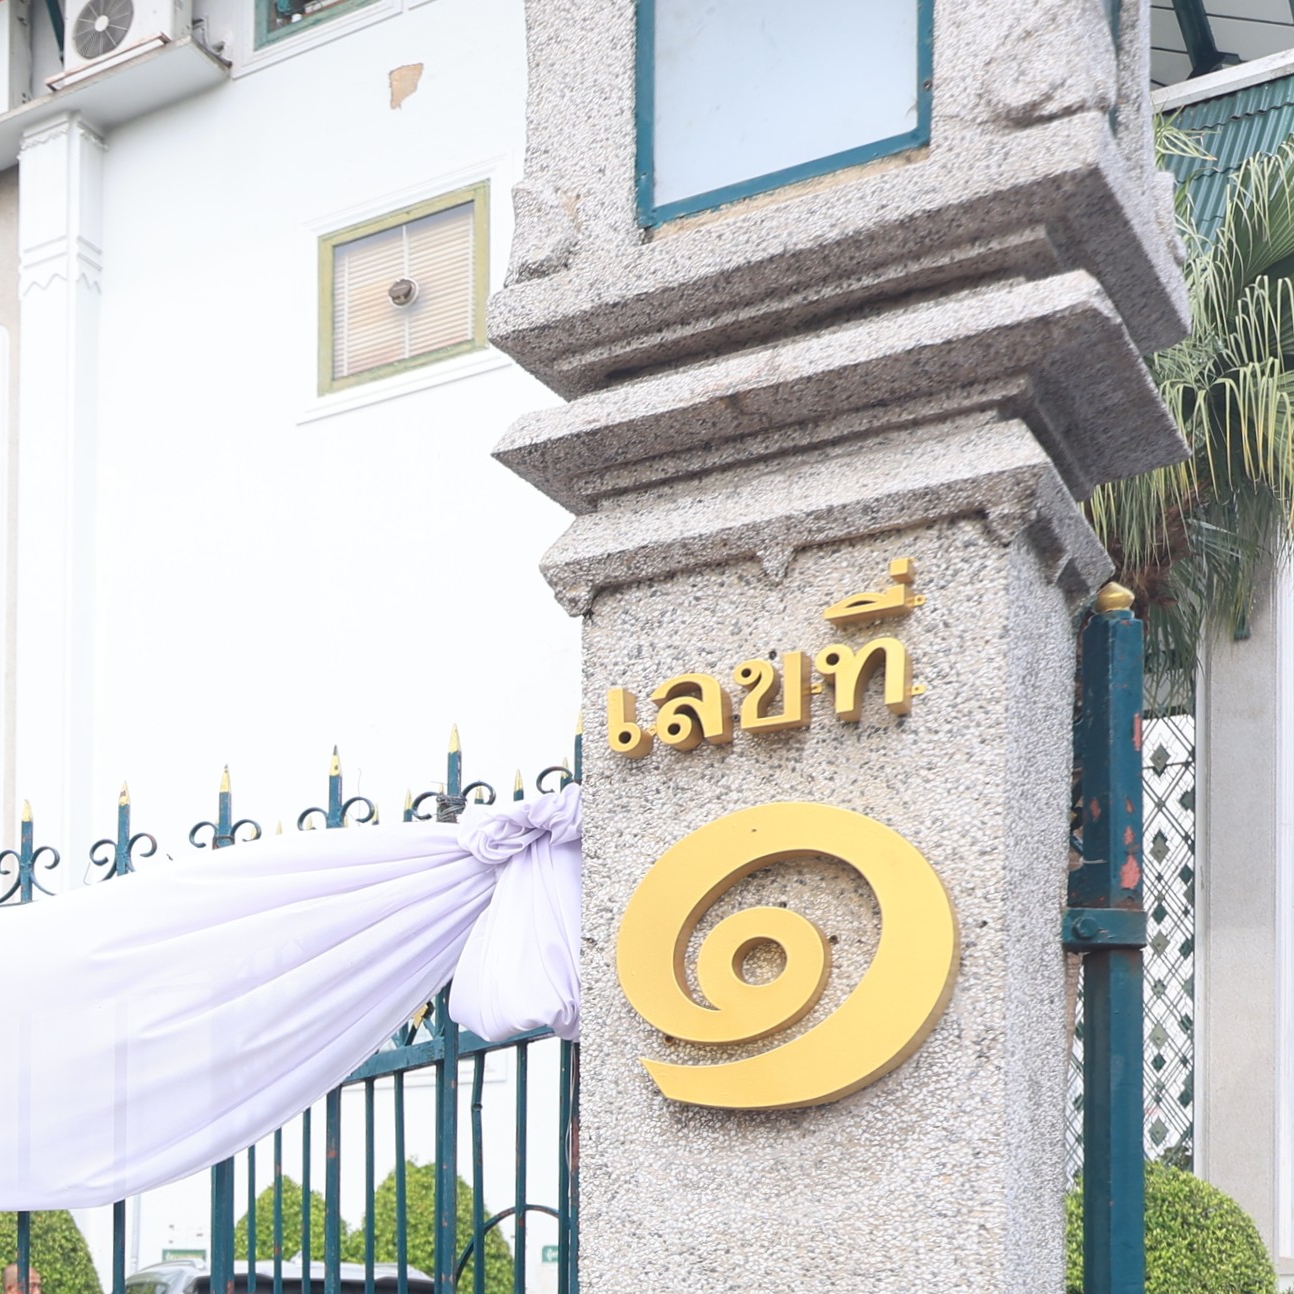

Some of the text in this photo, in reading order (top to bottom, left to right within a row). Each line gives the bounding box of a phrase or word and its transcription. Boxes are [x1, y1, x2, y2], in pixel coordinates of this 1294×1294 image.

[607, 558, 916, 759] เลขที่
[616, 801, 960, 1110] ๑
